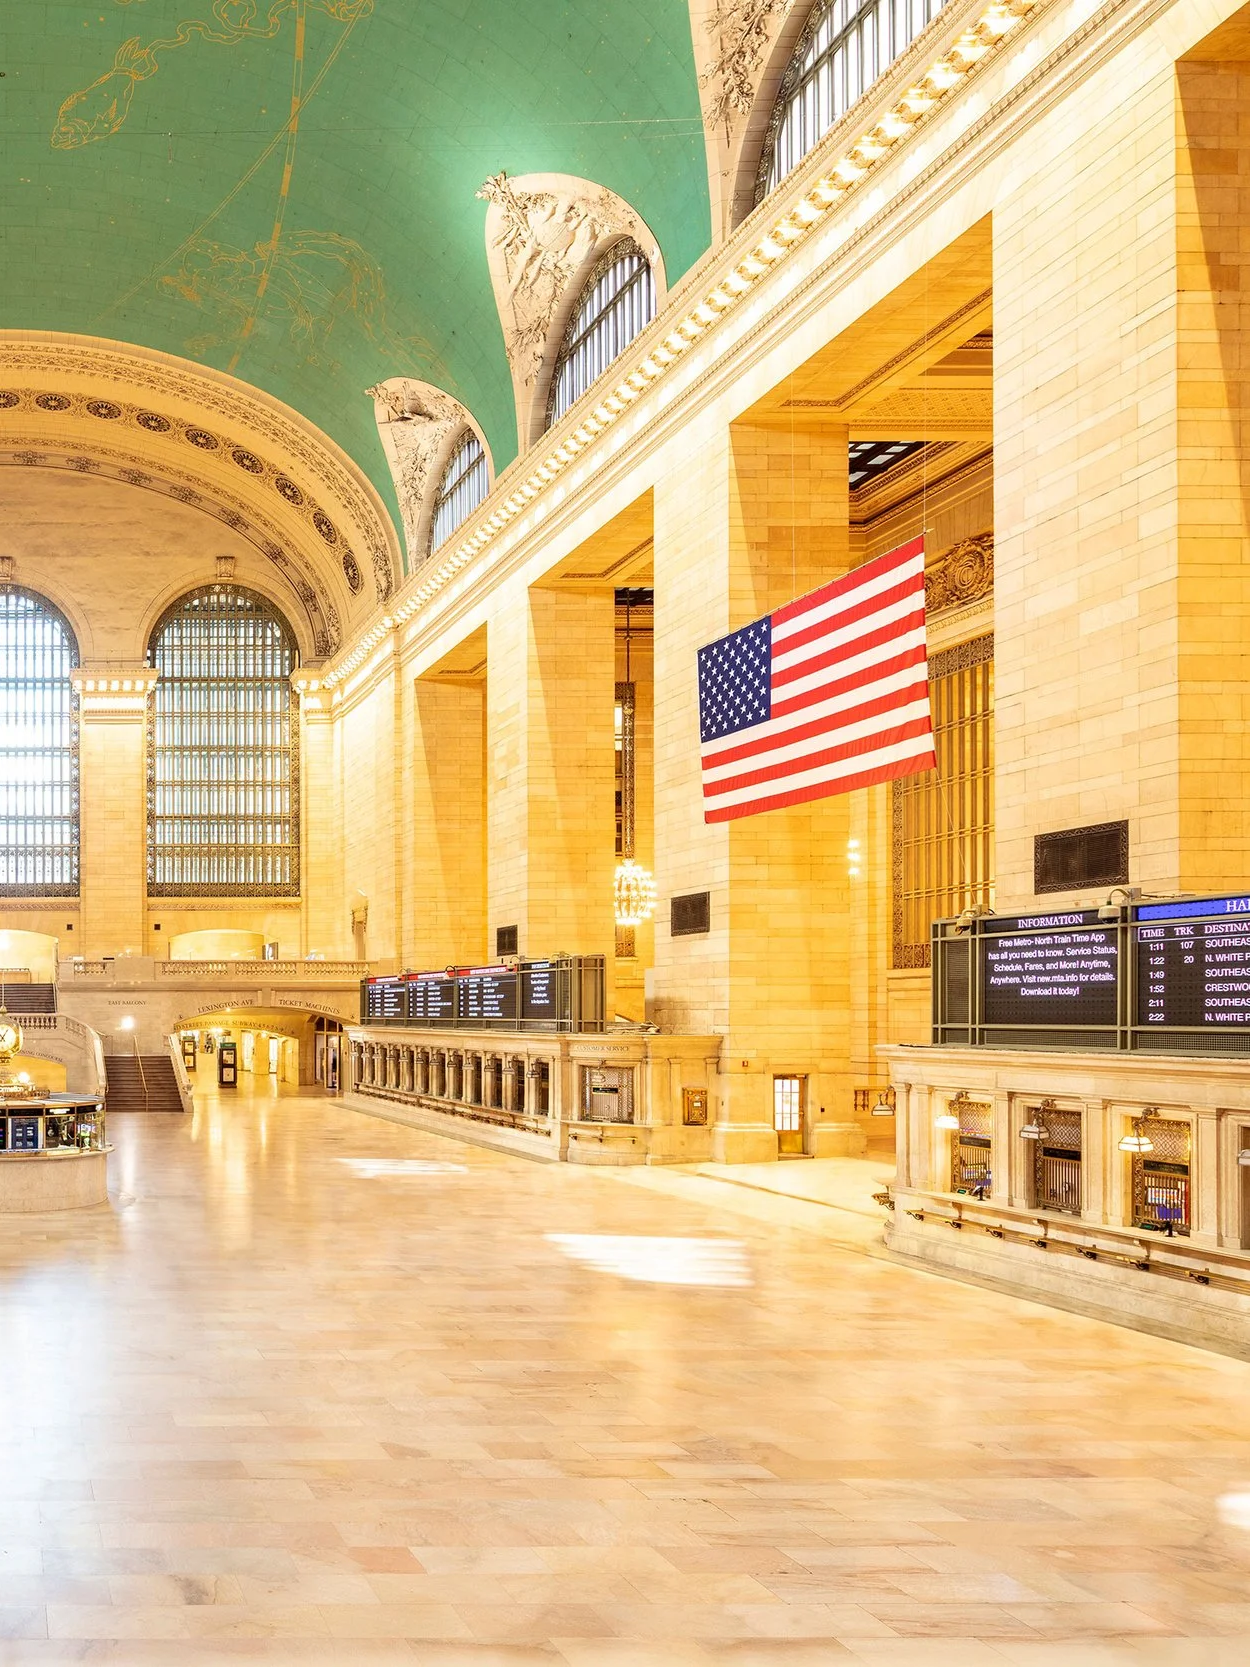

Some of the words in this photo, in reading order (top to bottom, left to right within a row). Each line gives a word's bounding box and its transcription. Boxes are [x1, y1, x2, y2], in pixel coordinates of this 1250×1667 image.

[1018, 914, 1083, 928] INFORMATION
[1141, 929, 1165, 938] TIME
[1174, 927, 1194, 936] TRK
[999, 939, 1013, 947] Free
[1035, 936, 1053, 945] North
[1053, 935, 1071, 944] Train
[1072, 934, 1089, 942] Time
[1090, 933, 1106, 942] App
[1149, 943, 1164, 951] 1:11
[1180, 941, 1194, 949] 107
[988, 952, 999, 960] has
[1021, 950, 1037, 958] need
[1045, 949, 1065, 957] know.
[1066, 947, 1091, 956] Service
[1093, 945, 1118, 954] Status,
[1149, 957, 1165, 965] 1:22
[1184, 956, 1194, 964] 20
[1205, 954, 1214, 962] N.
[1215, 953, 1244, 962] WHITE
[994, 963, 1024, 972] Schedule,
[1025, 962, 1045, 971] Fares,
[1046, 961, 1058, 970] and
[1060, 960, 1079, 969] More!
[1080, 959, 1111, 969] Anytime,
[990, 976, 1022, 985] Anywhere.
[1022, 975, 1036, 983] Visit
[1079, 973, 1089, 981] for
[1090, 972, 1116, 981] details.
[1149, 971, 1165, 979] 1:49
[1021, 987, 1052, 996] Download
[1053, 987, 1058, 995] it
[1059, 986, 1080, 996] today!
[1149, 985, 1165, 993] 1:52
[1205, 983, 1250, 992] CRESTWO
[198, 1001, 239, 1013] LEXINGTON
[279, 999, 302, 1007] TICKET
[305, 1002, 340, 1014] MACHINES
[1149, 999, 1164, 1007] 2:11
[1149, 1013, 1165, 1021] 2:22
[1205, 1013, 1214, 1022] N.
[1215, 1012, 1244, 1022] WHITE
